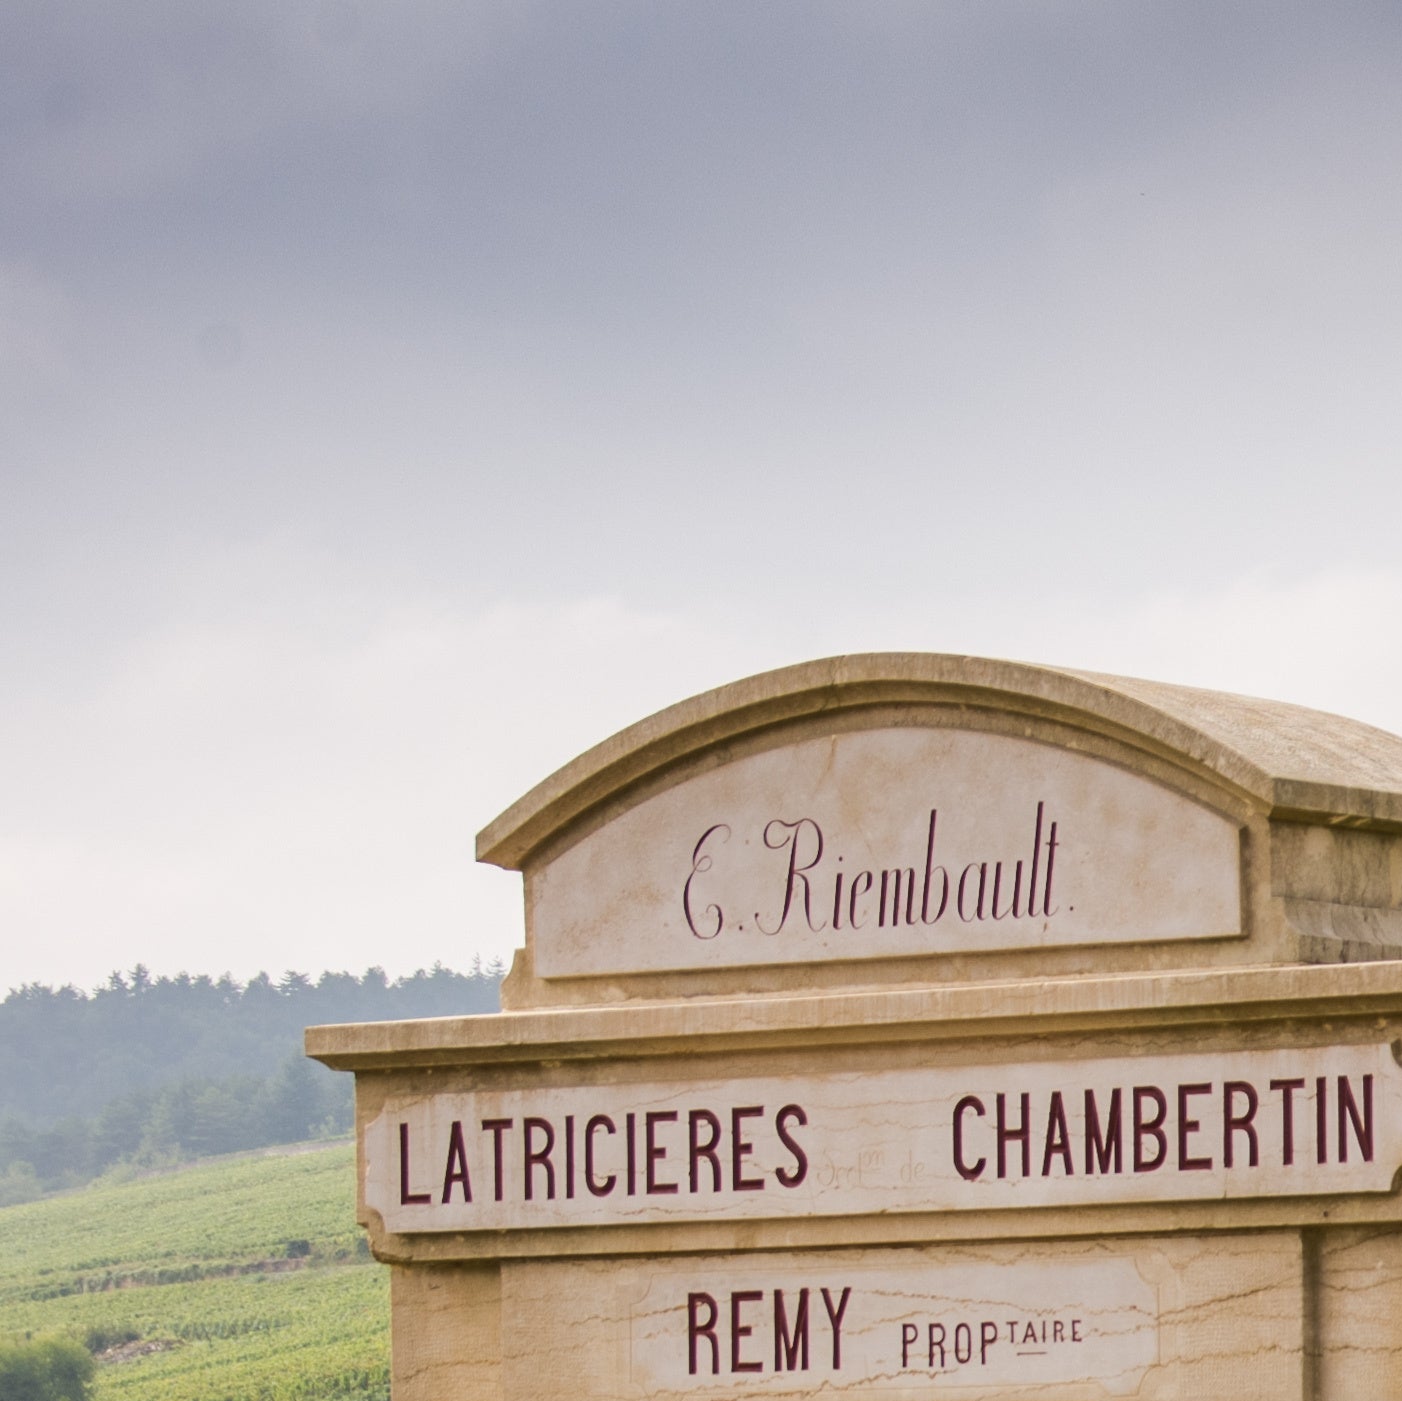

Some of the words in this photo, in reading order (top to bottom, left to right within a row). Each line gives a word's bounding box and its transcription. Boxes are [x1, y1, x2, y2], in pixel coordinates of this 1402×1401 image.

[399, 1103, 808, 1206] LATRICIERES
[952, 1073, 1375, 1182] CHAMBERTIN
[687, 1286, 852, 1375] REMY
